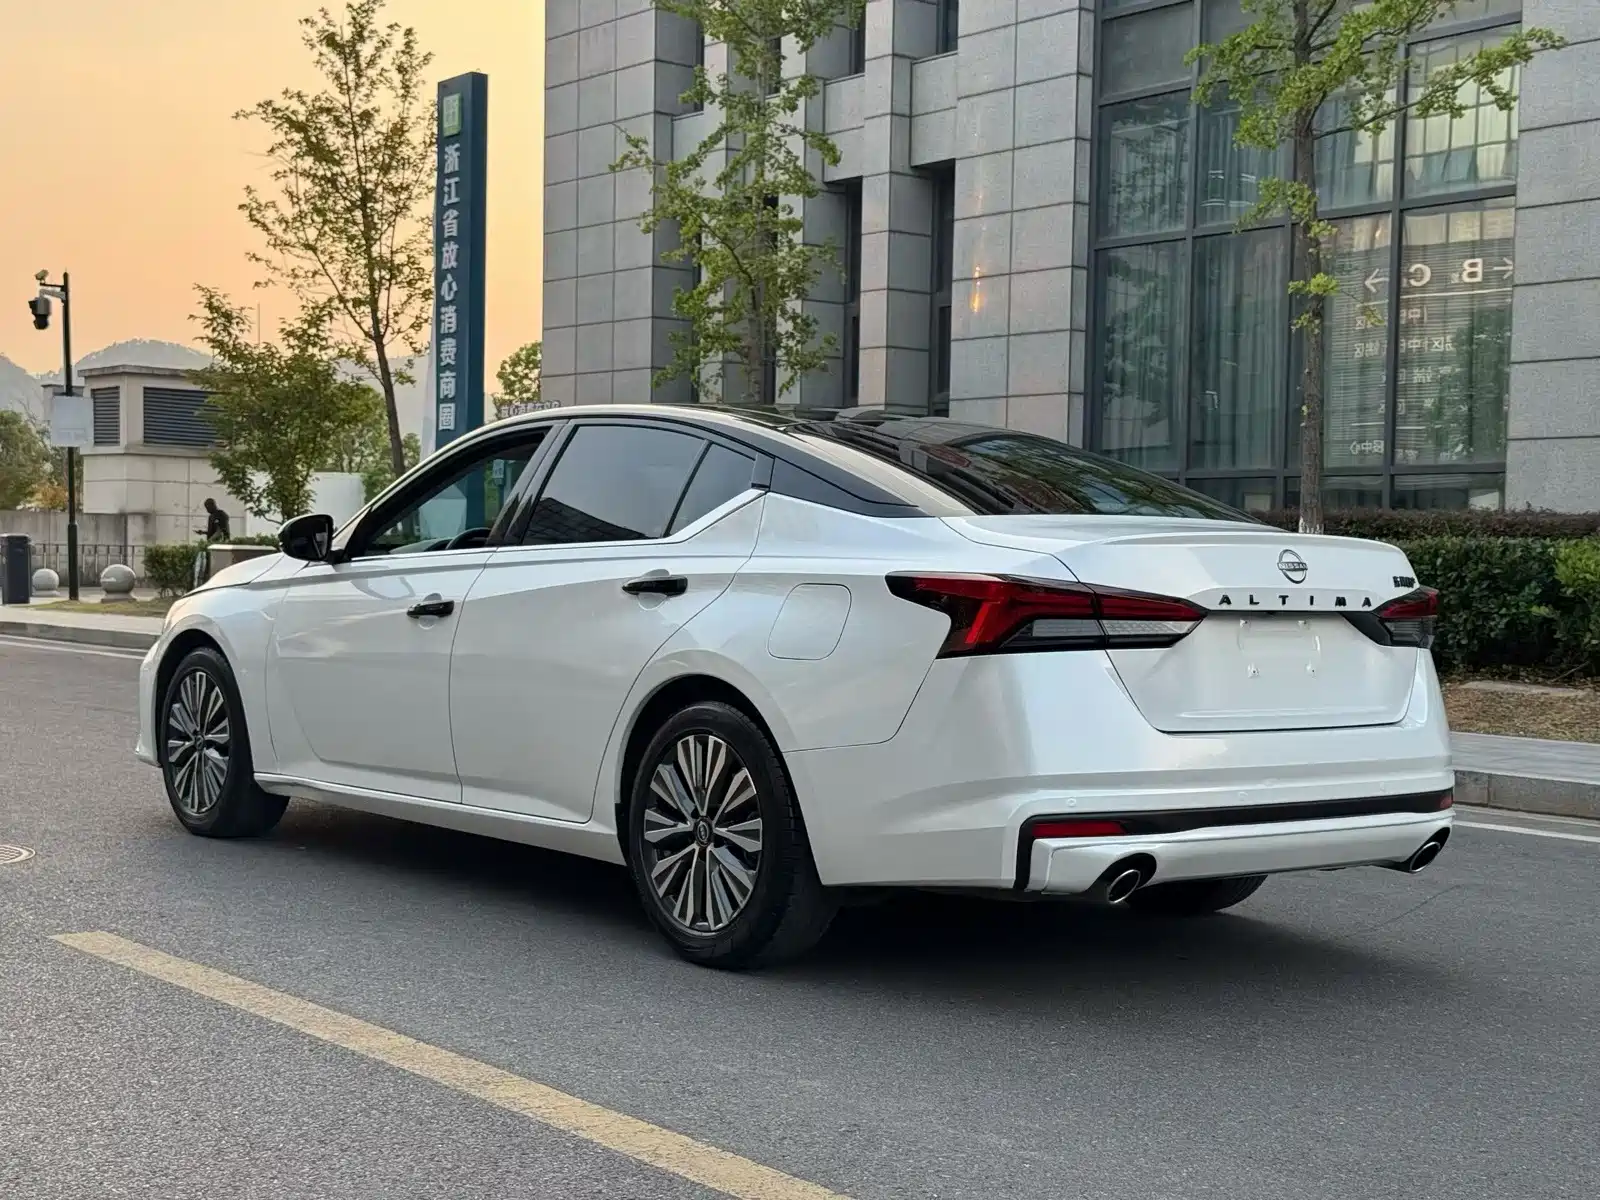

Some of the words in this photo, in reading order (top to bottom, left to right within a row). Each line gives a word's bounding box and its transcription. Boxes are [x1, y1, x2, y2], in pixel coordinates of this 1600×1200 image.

[438, 143, 461, 431] 浙江省放心消费商圈
[1218, 594, 1372, 608] ALTIMA
